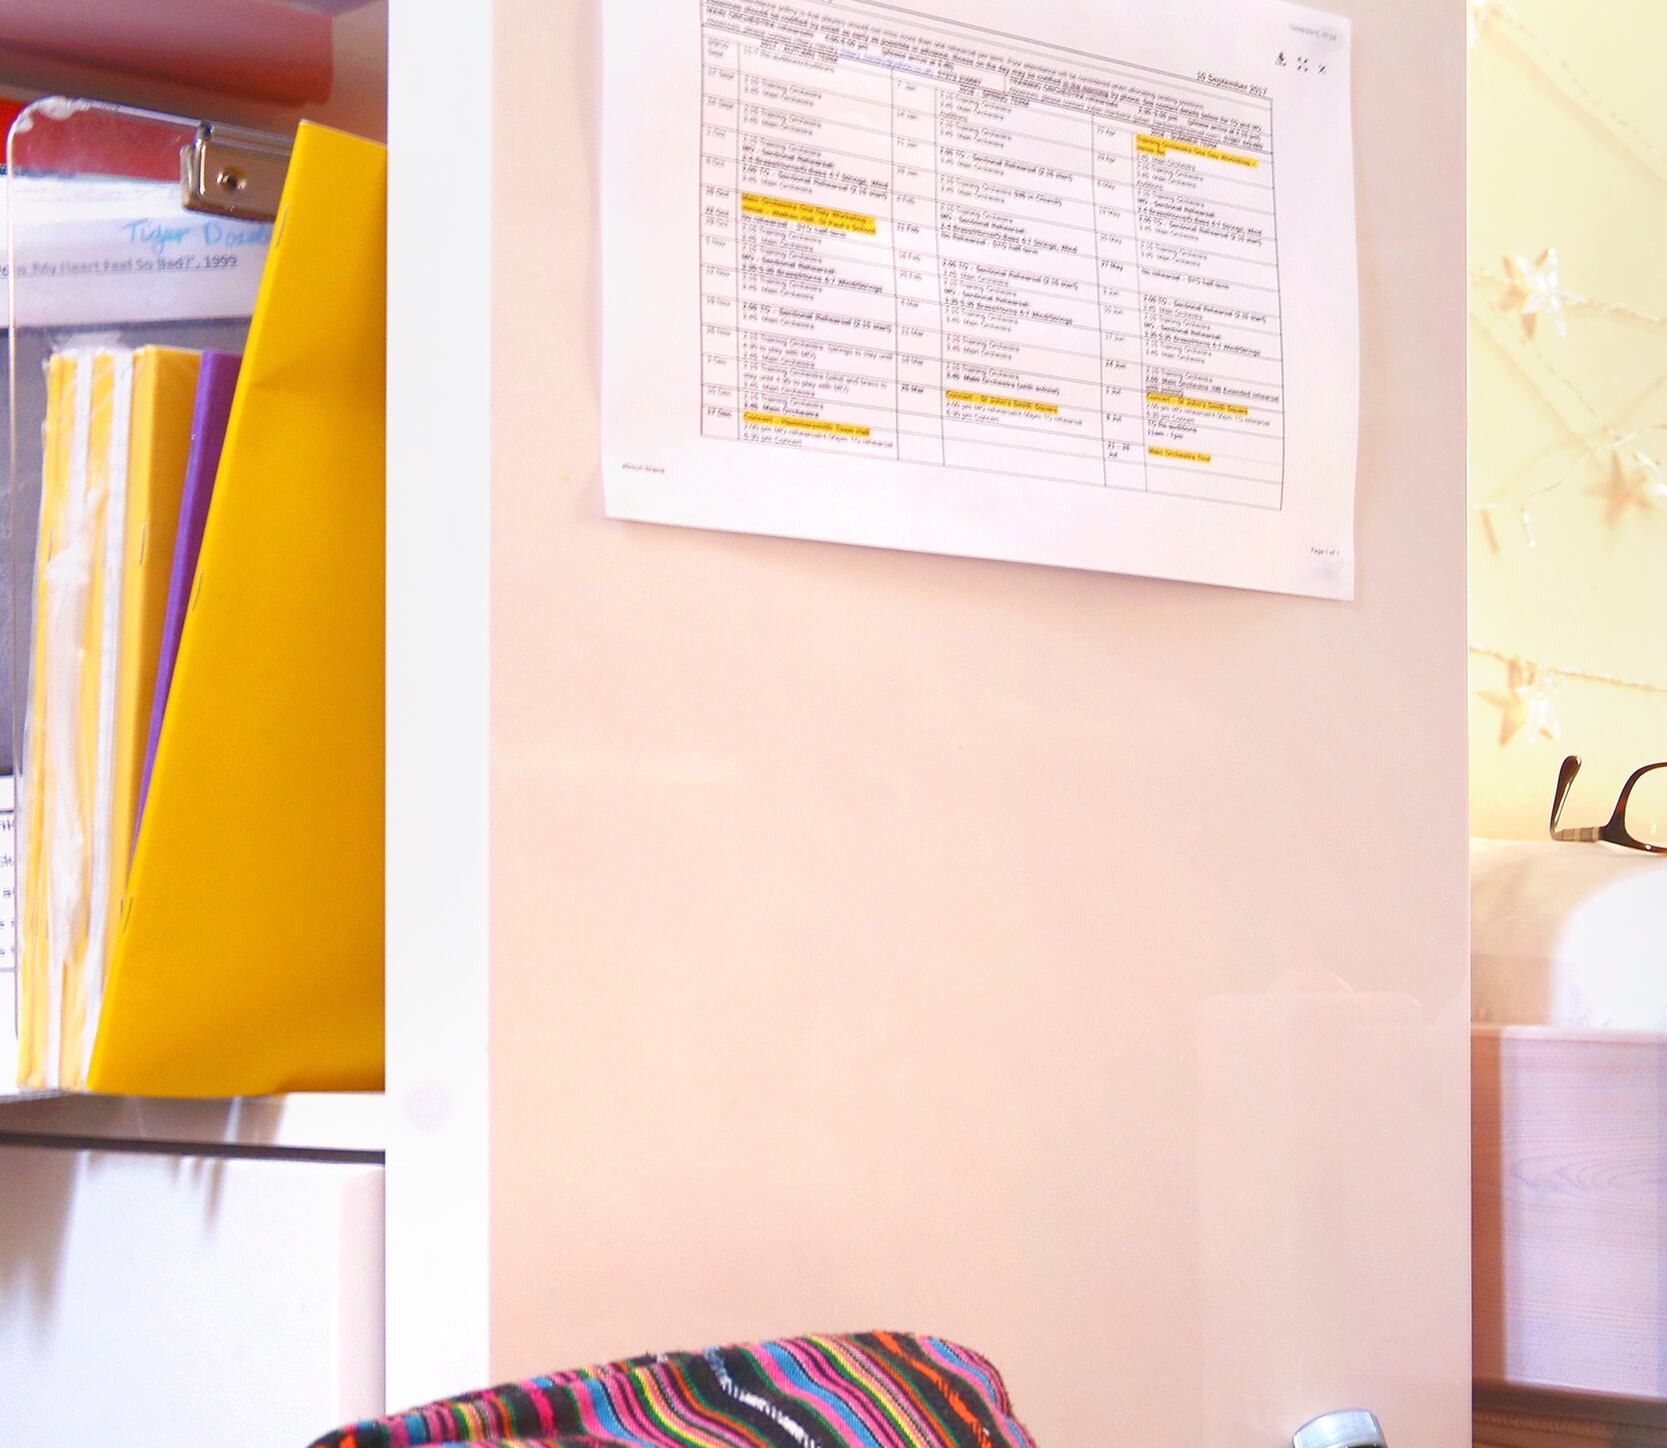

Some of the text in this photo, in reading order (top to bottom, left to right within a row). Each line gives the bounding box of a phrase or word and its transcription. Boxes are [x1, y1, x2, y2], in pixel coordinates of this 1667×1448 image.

[1207, 74, 1248, 92] September
[103, 258, 132, 272] Feel
[137, 259, 152, 271] So
[204, 254, 238, 268] 1999
